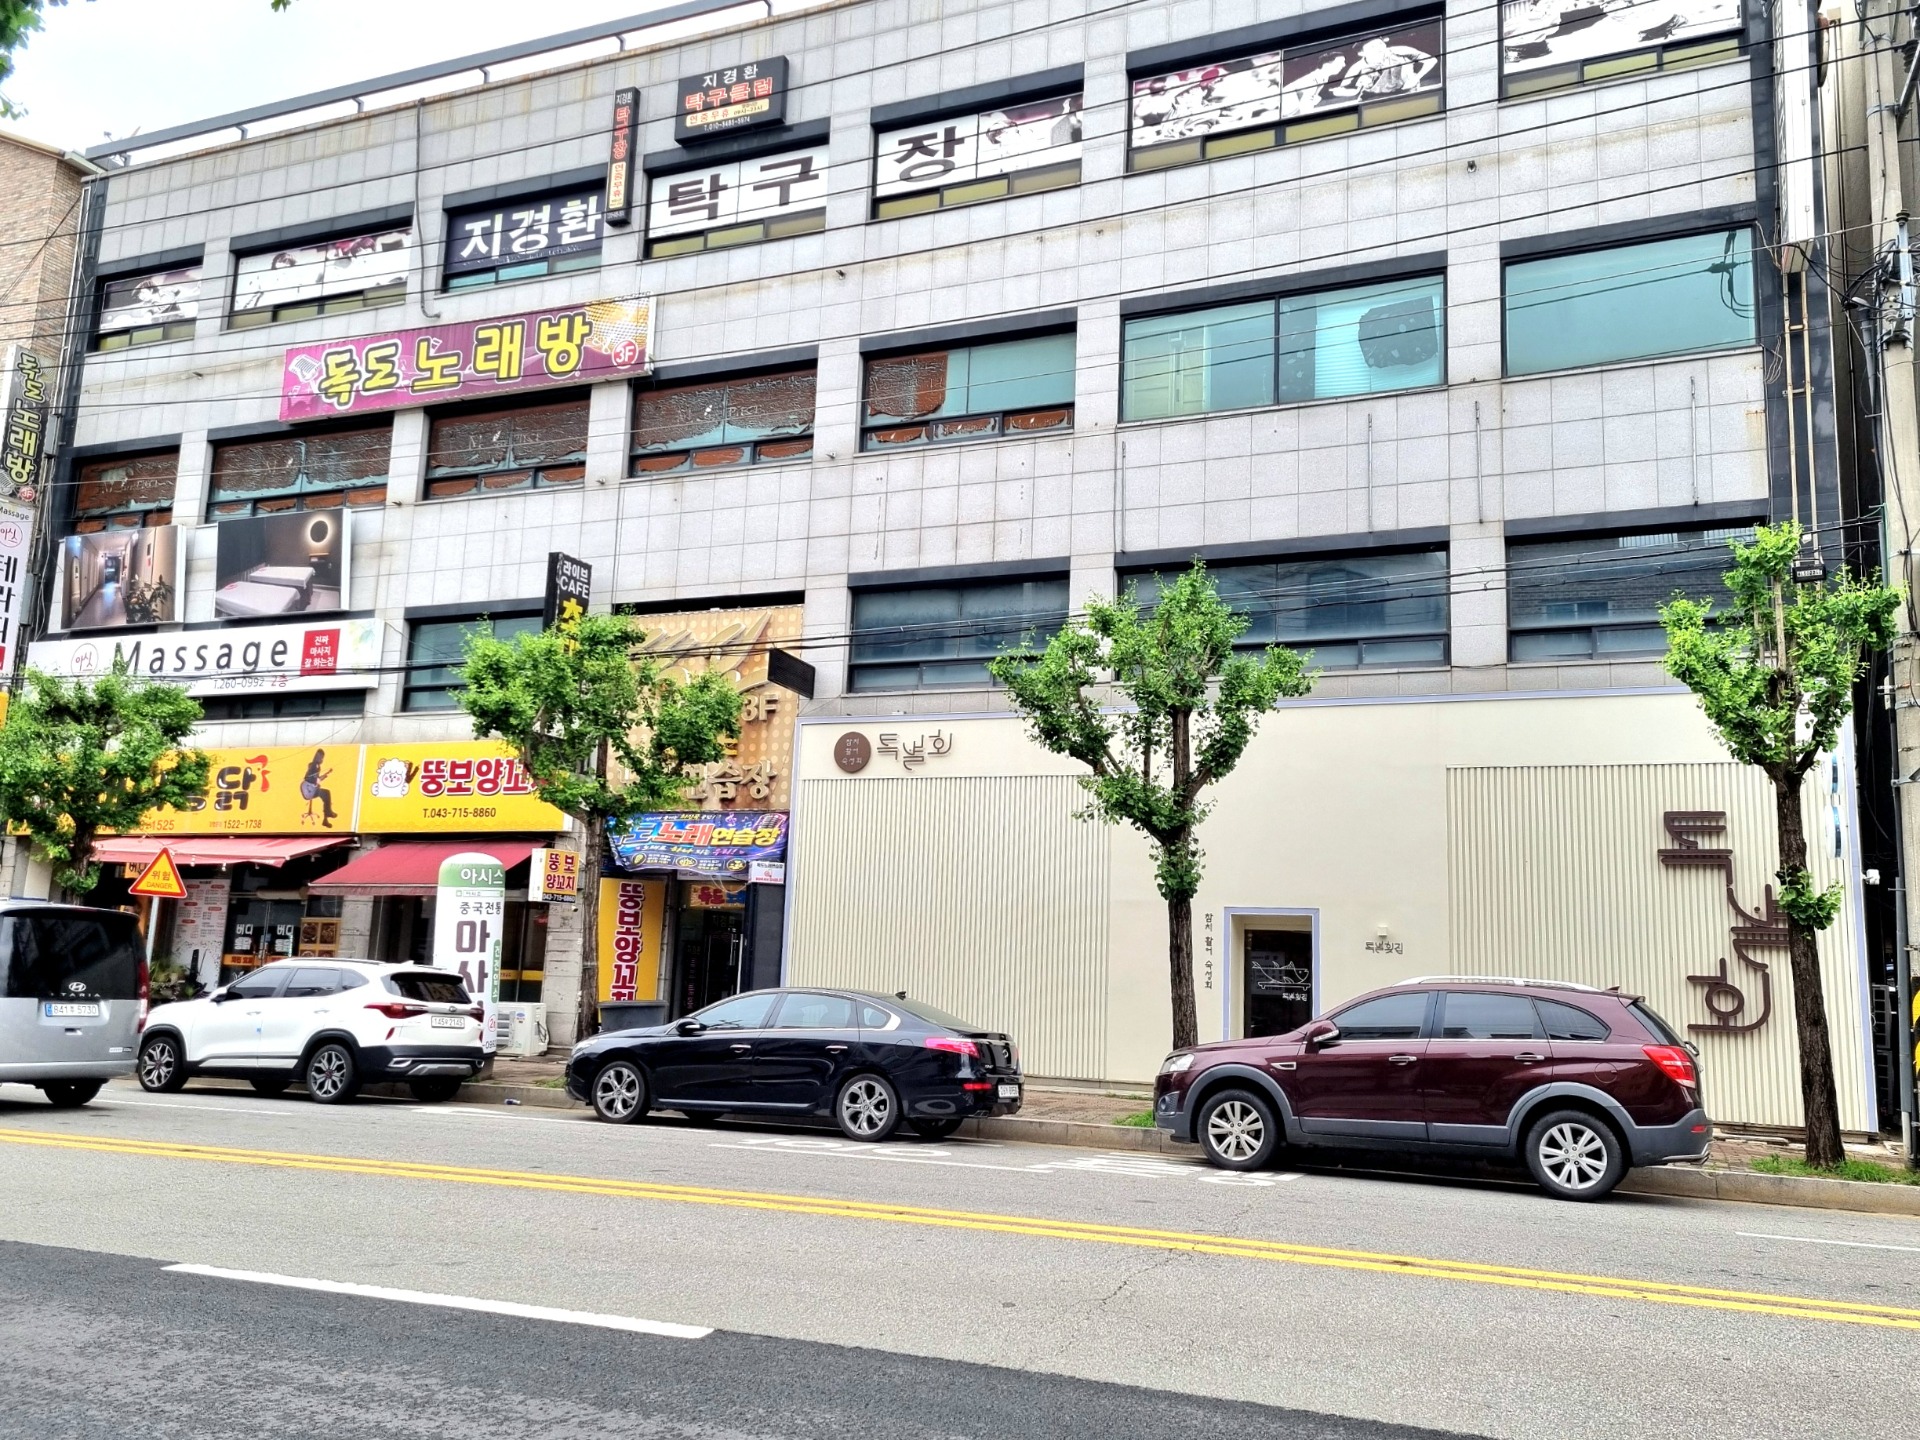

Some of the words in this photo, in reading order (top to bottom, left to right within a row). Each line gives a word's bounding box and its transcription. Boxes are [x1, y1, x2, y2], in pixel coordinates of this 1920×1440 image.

[702, 64, 758, 87] 지경환
[616, 92, 632, 104] 지경환
[685, 77, 773, 110] 탁구클럽
[614, 105, 630, 160] 탁구장
[460, 196, 602, 260] 지경환
[321, 343, 400, 408] 독도
[412, 313, 593, 392] 노래방
[615, 347, 636, 368] 3F
[18, 352, 44, 401] 독도
[6, 398, 40, 484] 노래방
[562, 561, 588, 582] 라이브
[560, 576, 589, 599] CAFE
[314, 635, 329, 645] 진짜
[113, 639, 288, 676] Massage
[309, 646, 331, 656] 마사지
[304, 659, 311, 668] 잘
[313, 656, 334, 667] 하는집
[213, 677, 265, 689] T.260-0992
[270, 674, 288, 688] 2층
[742, 694, 778, 721] 3F
[423, 808, 497, 819] T.043-715-8860
[223, 819, 262, 830] 1522-1738
[146, 881, 173, 889] DANGER
[151, 870, 171, 881] 위험
[545, 874, 576, 891] 양꼬치
[460, 901, 502, 915] 중국전통
[236, 924, 254, 935] 버디
[276, 925, 294, 935] 버디
[1205, 913, 1213, 932] 참치
[1205, 937, 1213, 956] 활어
[1205, 960, 1213, 990] 숙성회
